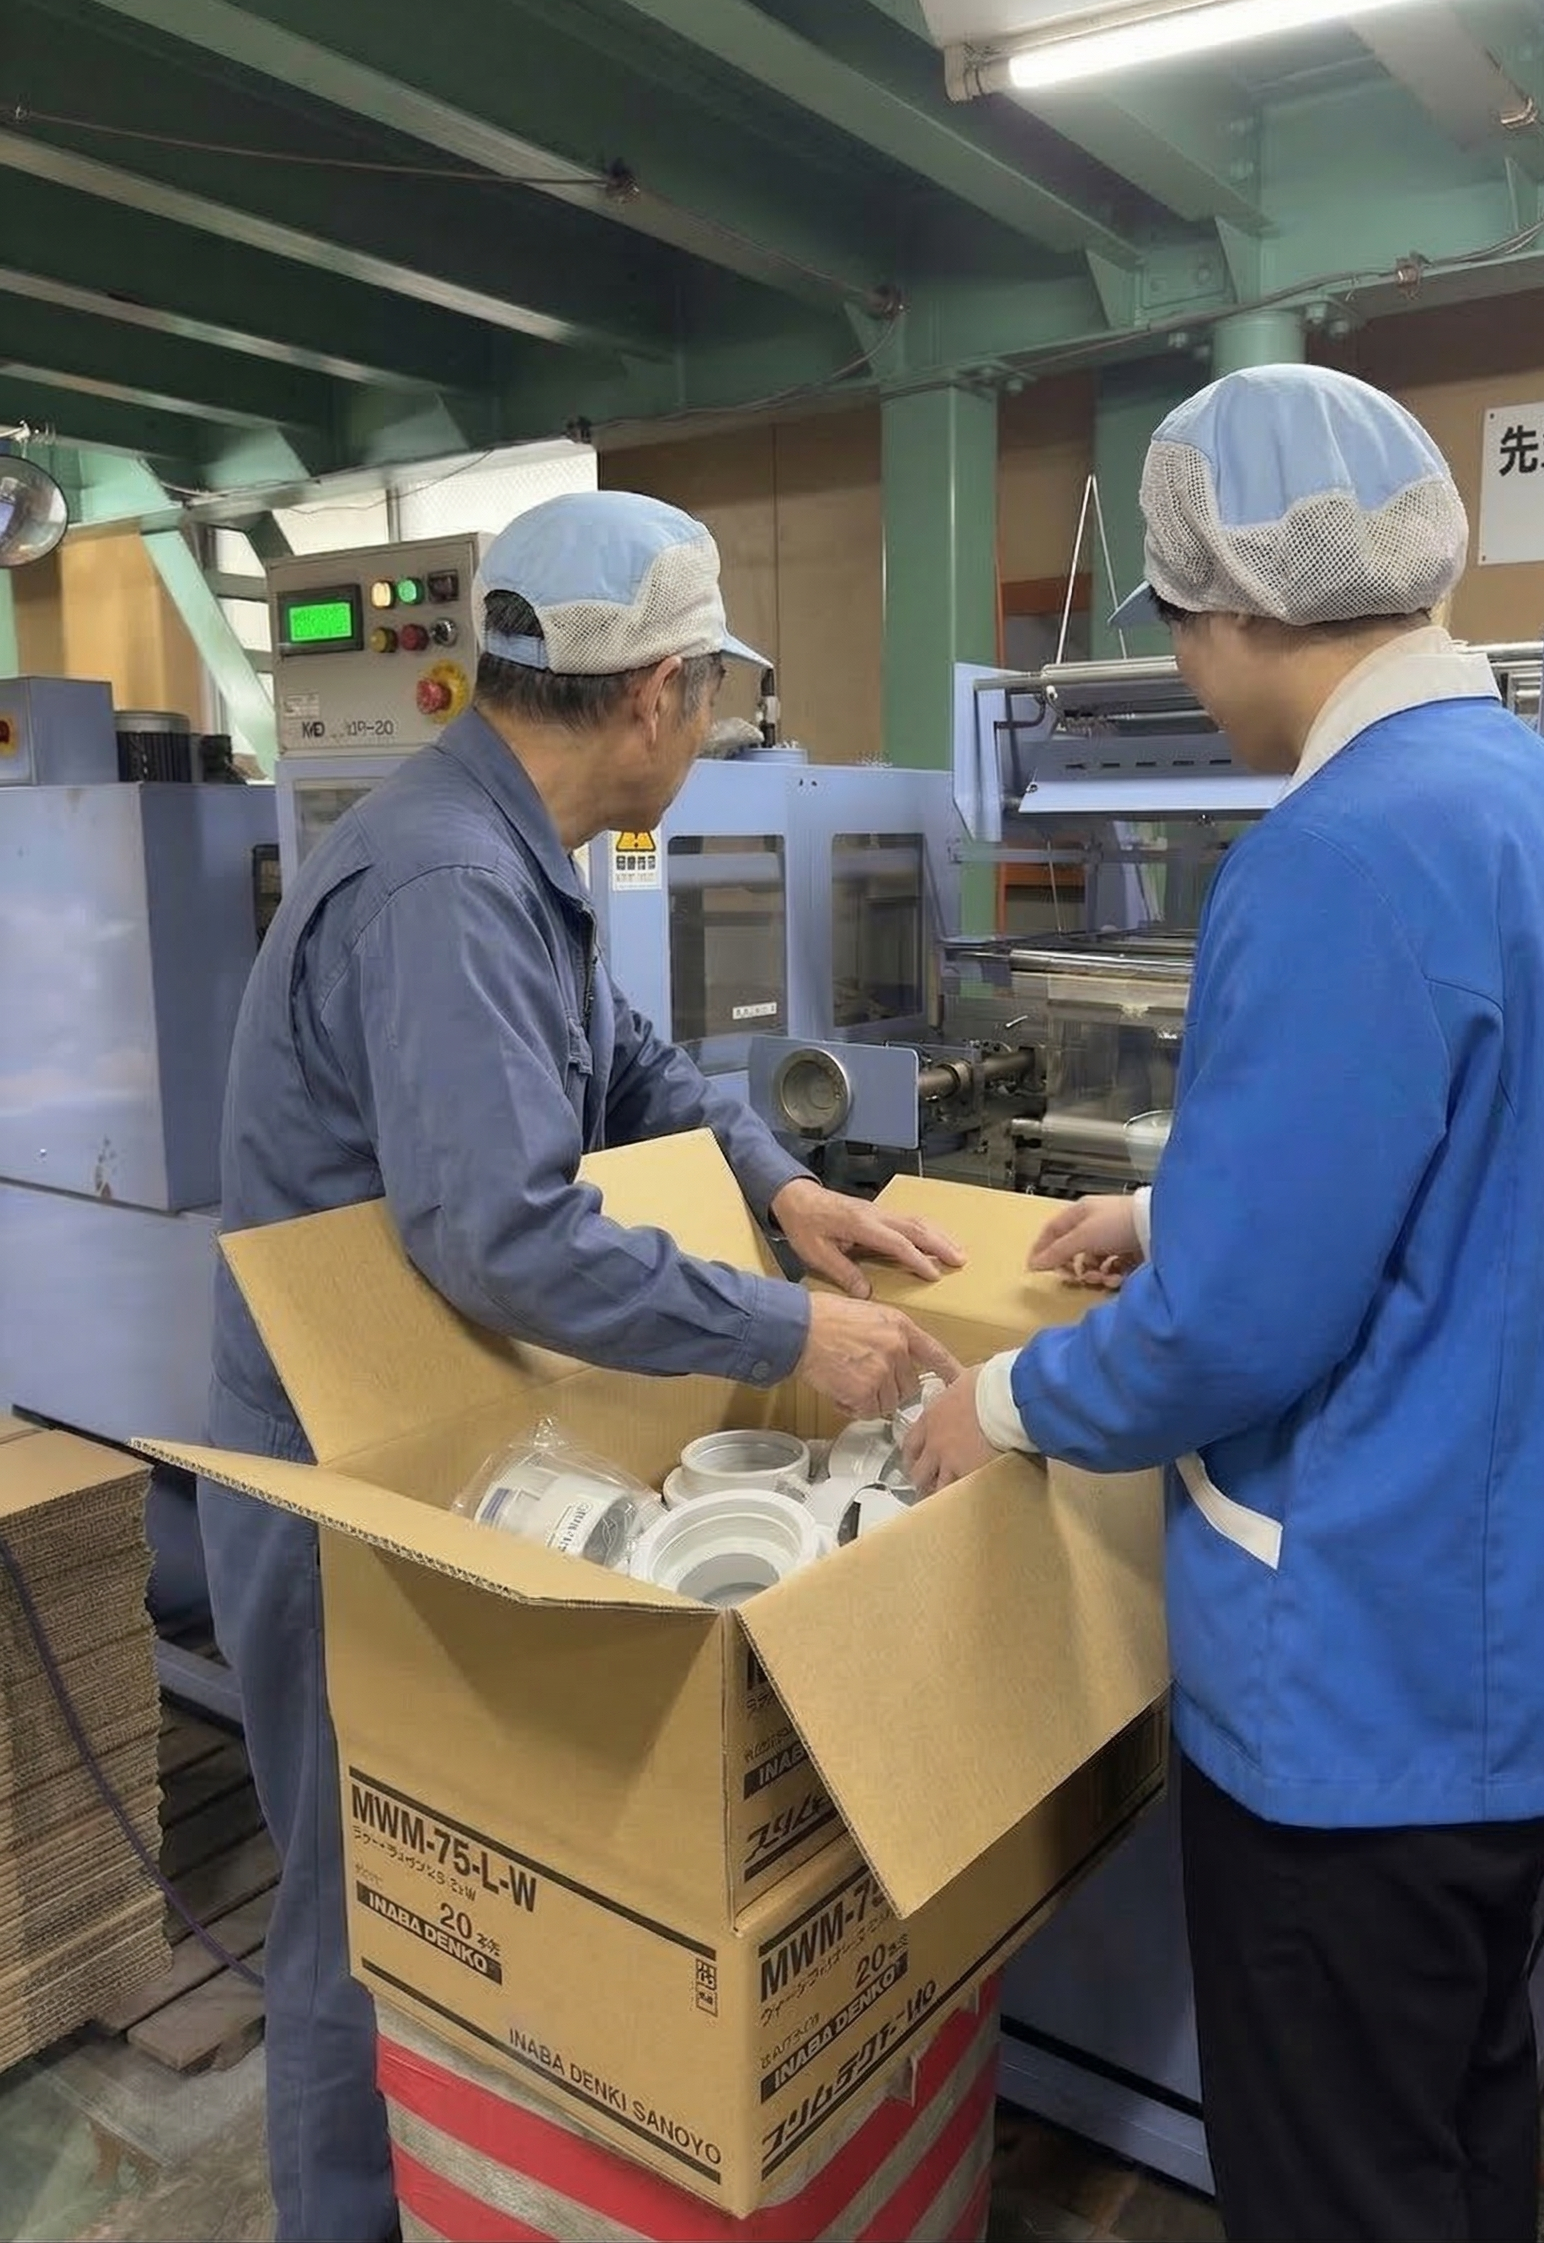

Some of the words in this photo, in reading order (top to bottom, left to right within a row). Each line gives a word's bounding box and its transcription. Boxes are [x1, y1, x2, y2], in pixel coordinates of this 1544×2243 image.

[1499, 425, 1544, 477] 先
[352, 1784, 537, 1913] MWM-75-L-W
[368, 1891, 422, 1937] INABA
[424, 1925, 488, 1973] DENKO
[440, 1902, 472, 1940] 20
[855, 1943, 885, 1990] 20
[774, 2023, 834, 2089] INABA
[835, 1965, 896, 2033] DENKO
[509, 2028, 565, 2076] INABA
[570, 2062, 627, 2111] DENKI
[632, 2100, 722, 2165] SANOYO
